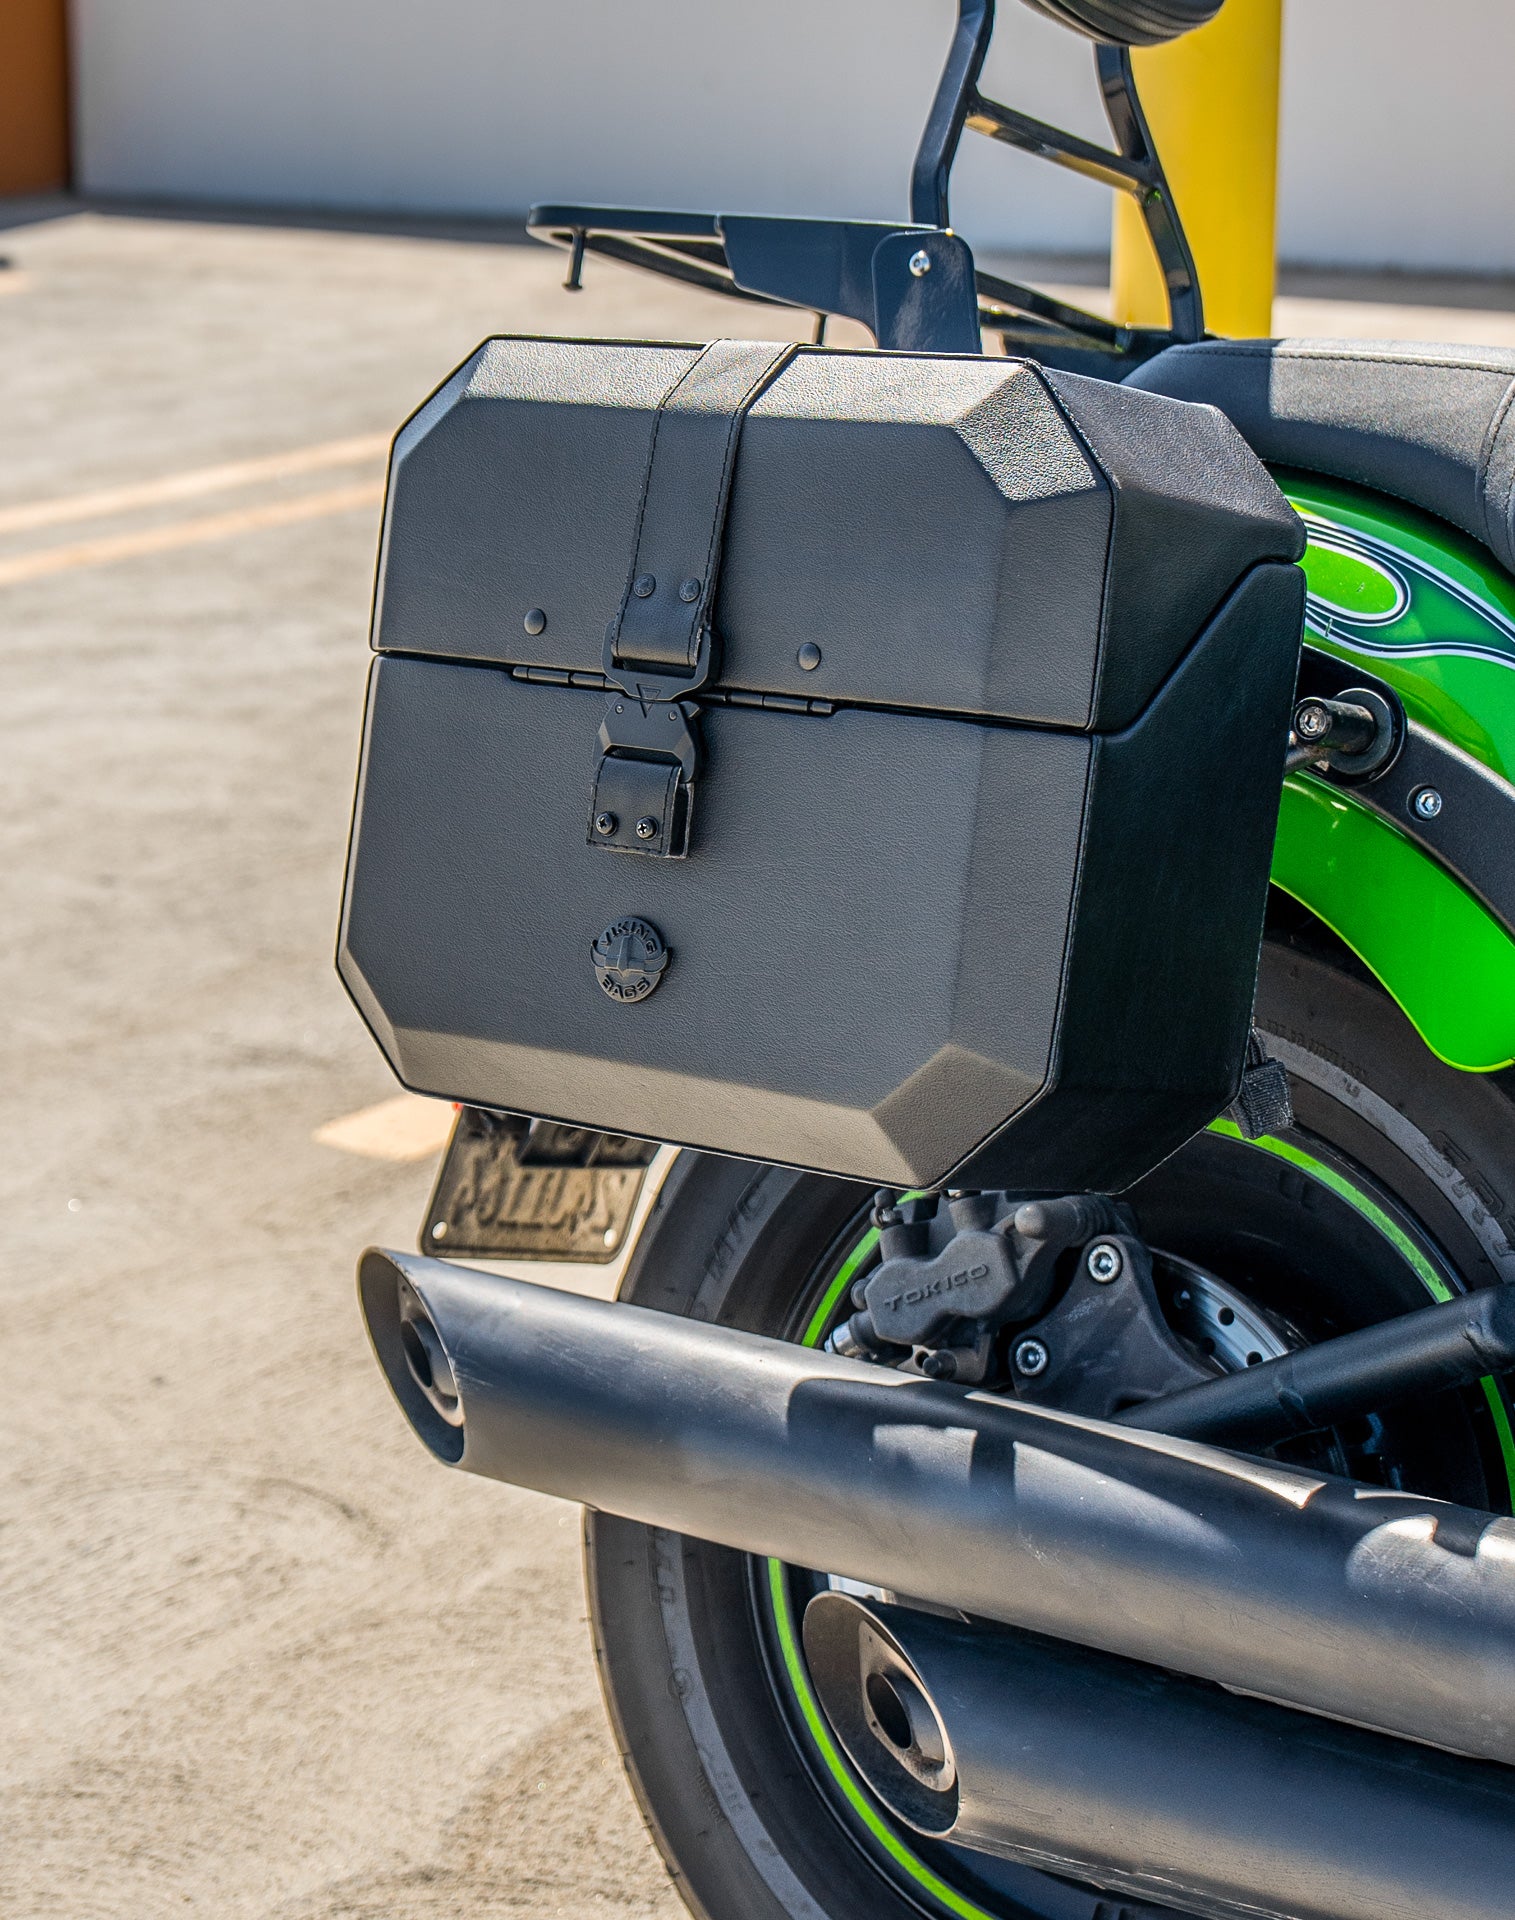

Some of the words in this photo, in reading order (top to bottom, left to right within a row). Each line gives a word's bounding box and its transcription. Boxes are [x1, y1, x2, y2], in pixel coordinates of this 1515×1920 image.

[600, 920, 658, 955] VIKING
[602, 974, 650, 999] BAGS
[883, 1263, 990, 1311] TOKICO
